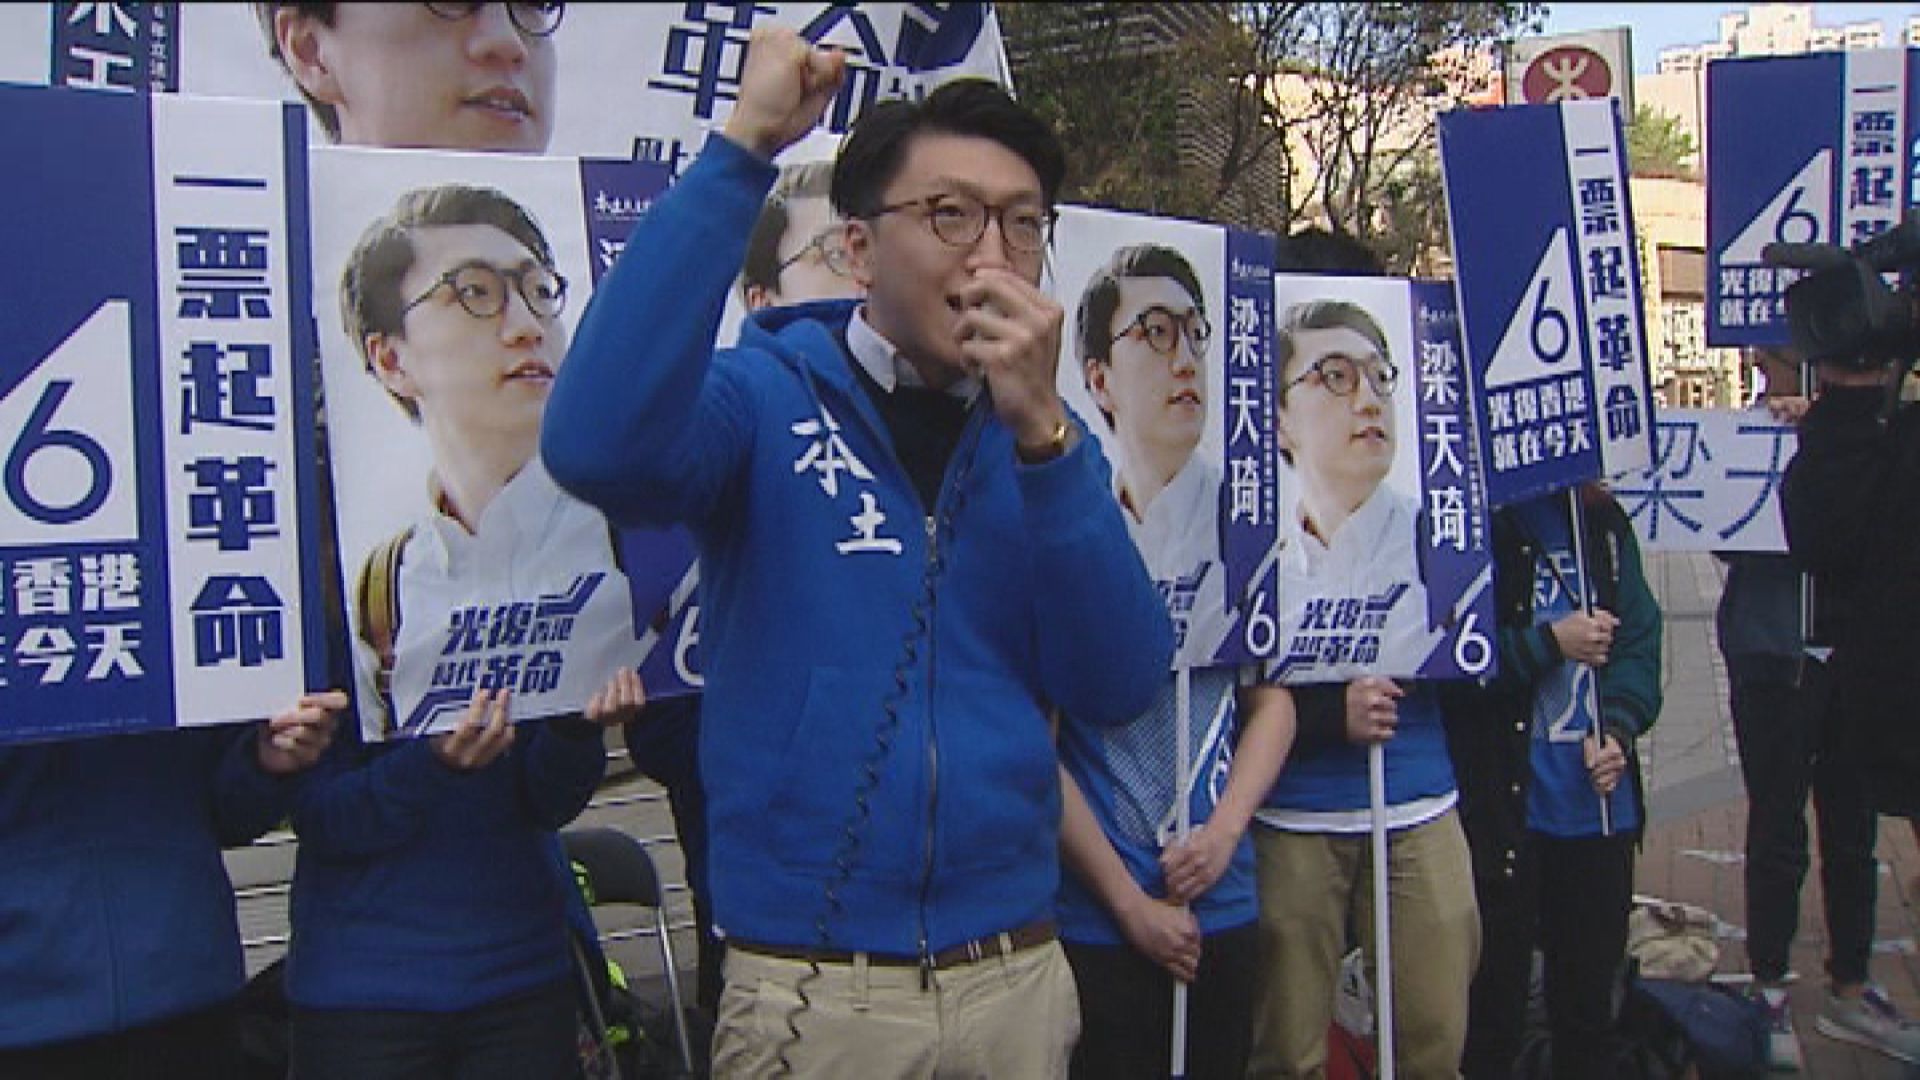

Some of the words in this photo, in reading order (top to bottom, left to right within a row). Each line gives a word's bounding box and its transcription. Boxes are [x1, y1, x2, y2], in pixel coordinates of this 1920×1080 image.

[1774, 186, 1819, 243] 6
[1531, 275, 1569, 363] 6
[1574, 146, 1641, 441] 一票起革命
[4, 380, 113, 524] 6
[172, 175, 286, 666] 一票起革命
[1230, 295, 1261, 525] 梁天琦
[1421, 340, 1467, 551] 梁天琦
[1491, 417, 1591, 473] 就在今天
[791, 405, 902, 555] 本土
[0, 553, 142, 616] 香港
[1246, 592, 1276, 657] 6
[0, 621, 145, 686] 今天
[1455, 613, 1492, 674] 6
